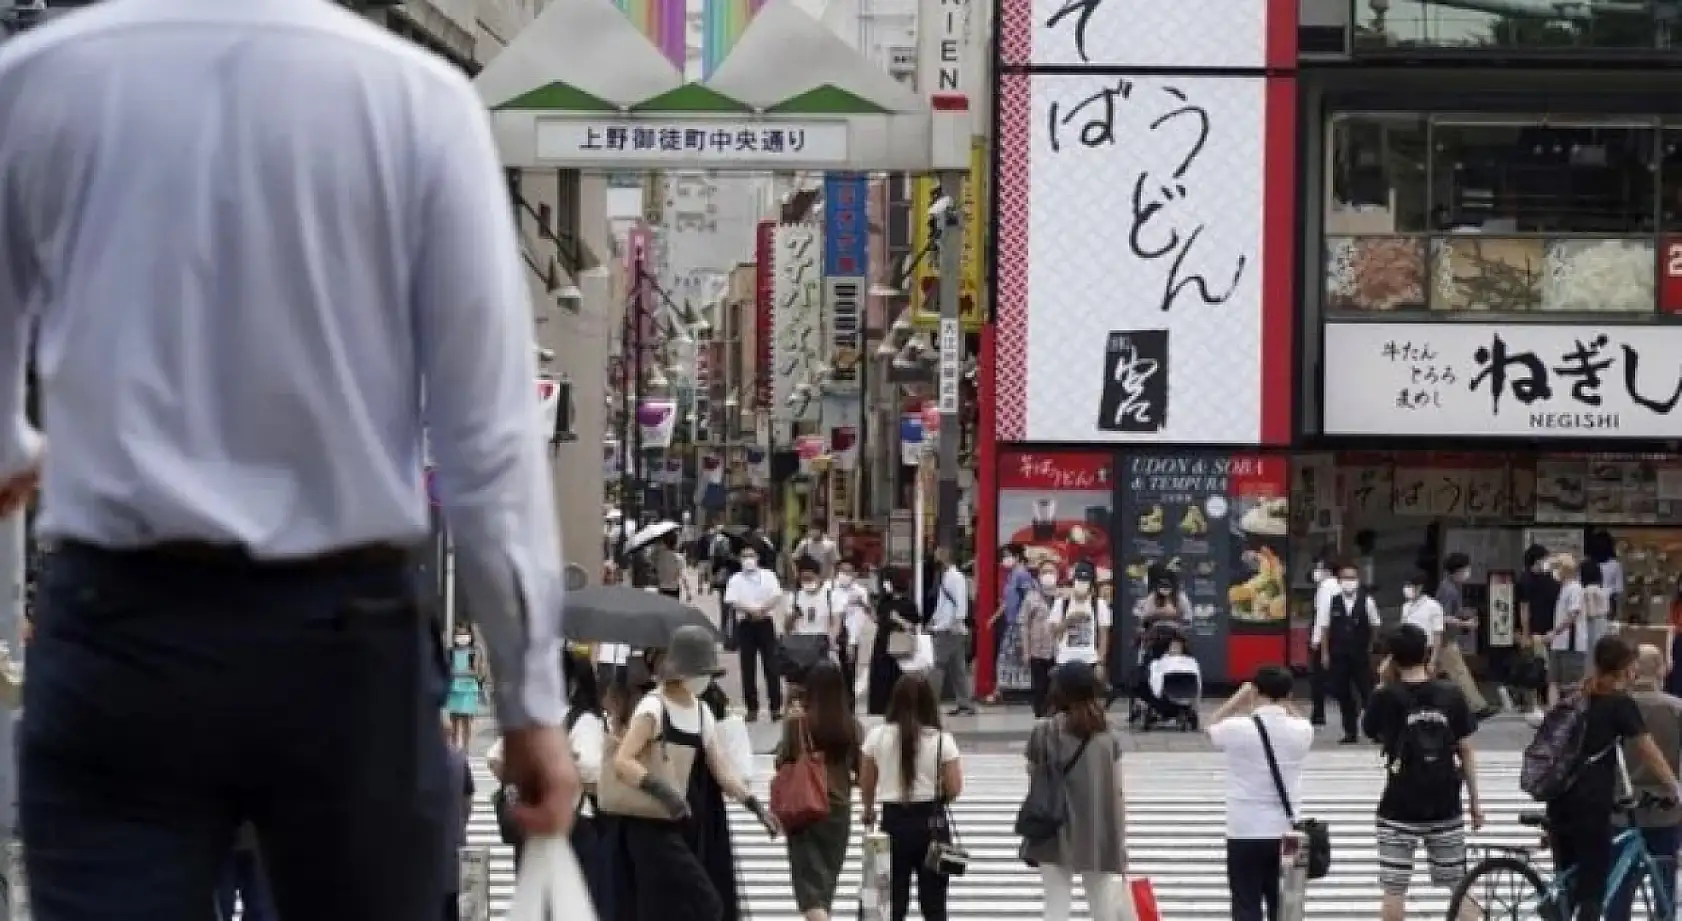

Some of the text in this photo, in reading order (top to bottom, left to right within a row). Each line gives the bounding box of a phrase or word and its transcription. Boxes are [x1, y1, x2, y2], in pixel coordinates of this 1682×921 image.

[940, 0, 961, 90] IEN
[579, 126, 805, 152] 上野御徒町中央通り
[1129, 86, 1246, 312] うどん
[1381, 340, 1439, 361] 牛たん
[1411, 364, 1456, 384] とろろ
[1468, 331, 1682, 415] ねぎし
[1529, 412, 1620, 430] NEGISHI
[1131, 458, 1264, 475] UDON & SOBA
[1131, 477, 1142, 491] &
[1149, 477, 1228, 491] TEMPURA
